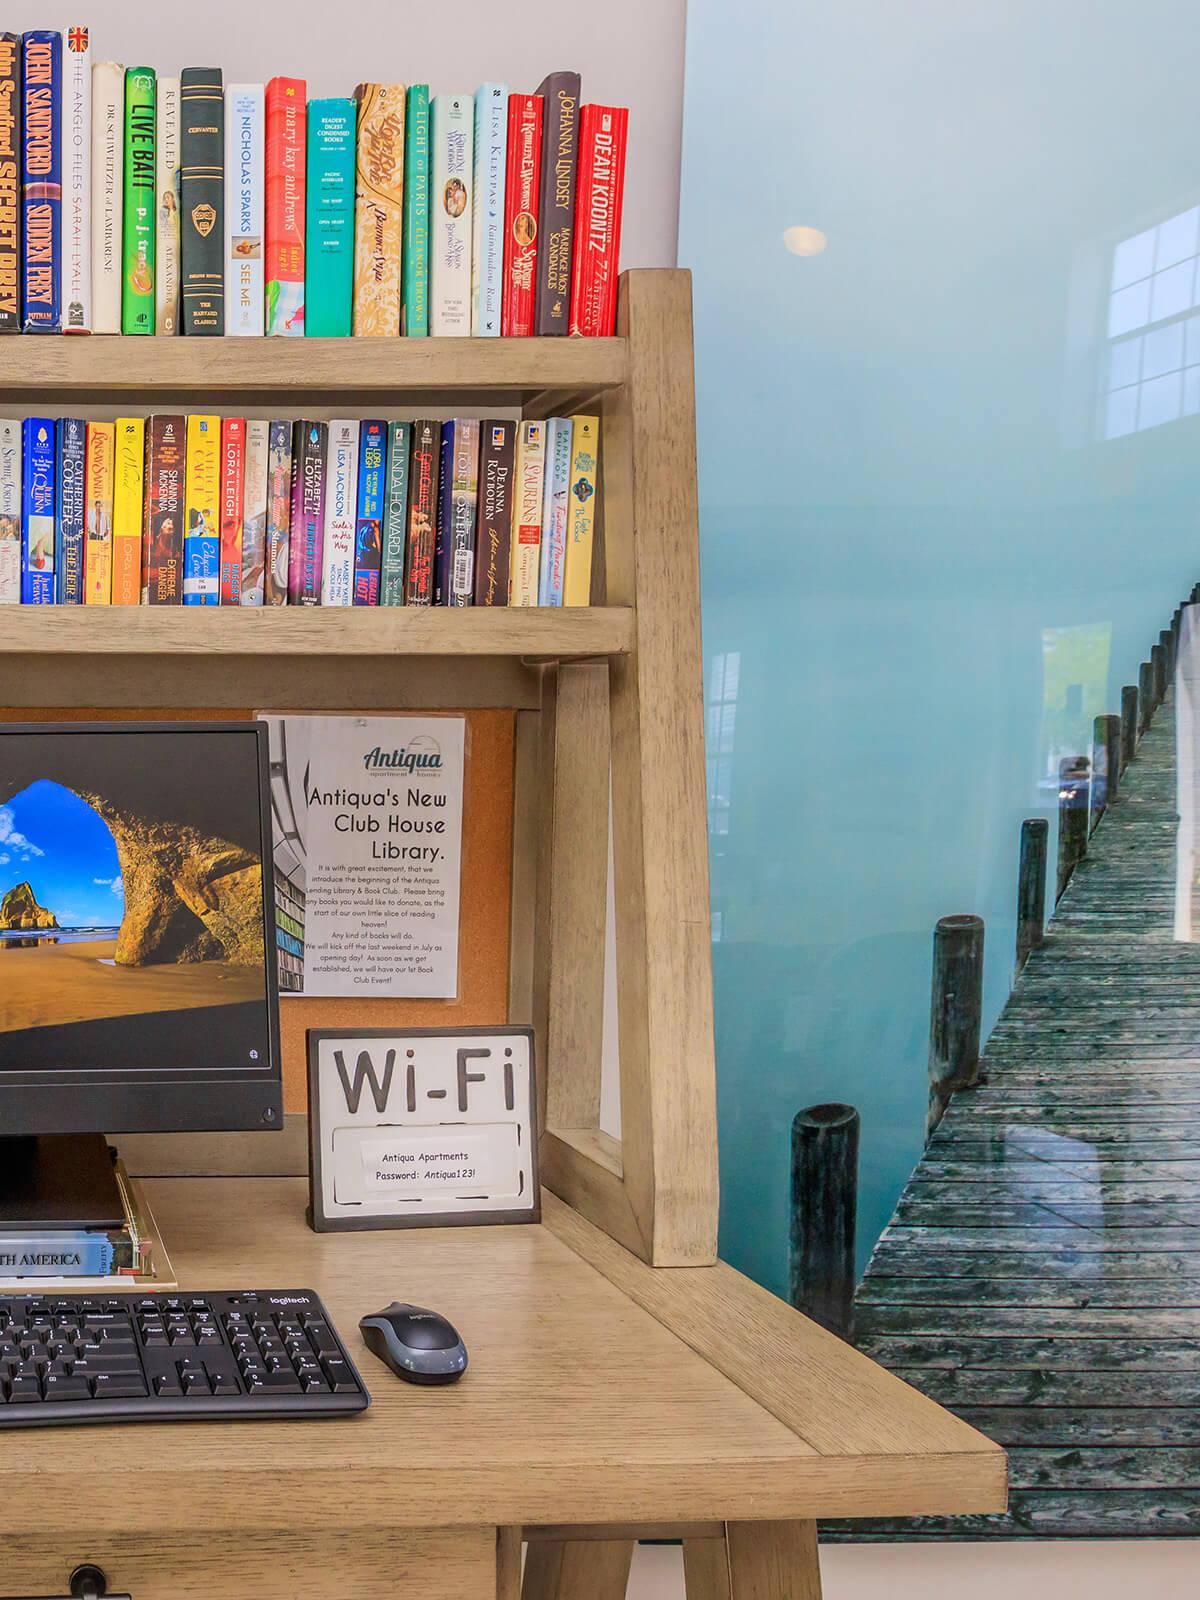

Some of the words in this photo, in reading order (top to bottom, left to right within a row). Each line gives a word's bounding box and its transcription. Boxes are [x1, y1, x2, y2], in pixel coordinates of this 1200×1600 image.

[26, 38, 52, 85] JOHN
[26, 88, 52, 175] SANDFORD
[131, 105, 154, 143] LIVE
[282, 106, 296, 143] mary
[491, 106, 502, 138] LISA
[558, 91, 576, 156] JOHANNA
[132, 151, 154, 190] BAIT
[241, 117, 251, 185] NICHOLAS
[282, 147, 300, 174] kay
[592, 133, 612, 181] DEAN
[488, 146, 501, 205] KLEYPAS
[555, 159, 573, 210] LINDSEY
[241, 190, 251, 233] SPARKS
[285, 175, 300, 231] andrews
[589, 184, 609, 253] KOONTZ
[26, 204, 52, 264] SUDDEN
[241, 265, 250, 285] SEE
[279, 248, 287, 272] night
[26, 266, 52, 305] PREY
[241, 289, 250, 306] ME
[226, 443, 234, 476] LORA
[337, 449, 345, 468] LISA
[392, 449, 404, 487] LINDA
[62, 459, 74, 525] COULTER
[73, 461, 83, 525] CATHERINE
[168, 470, 177, 512] SHANNON
[226, 480, 235, 517] LEIGH
[304, 457, 313, 514] LOWELL
[313, 458, 321, 515] ELIZABETH
[336, 470, 344, 517] JACKSON
[485, 460, 497, 520] RAYBOURN
[496, 467, 508, 513] DEANNA
[522, 463, 541, 523] LAURENS
[389, 491, 402, 555] HOWARD
[158, 567, 167, 600] DANGER
[167, 559, 176, 597] EXTREME
[364, 747, 443, 773] Antiqua
[309, 788, 399, 809] Antiqua's
[408, 789, 446, 807] New
[335, 815, 380, 833] Club
[389, 815, 446, 833] House
[348, 865, 366, 873] great
[372, 841, 444, 862] Library.
[332, 932, 344, 940] Any
[333, 1048, 514, 1113] Wi-Fi
[376, 1171, 420, 1180] Password:
[424, 1169, 476, 1180] Antiqua123!
[382, 1153, 415, 1163] Antiqua
[419, 1152, 469, 1162] Apartments
[19, 1254, 81, 1265] AMERICA
[270, 1297, 310, 1305] logitech
